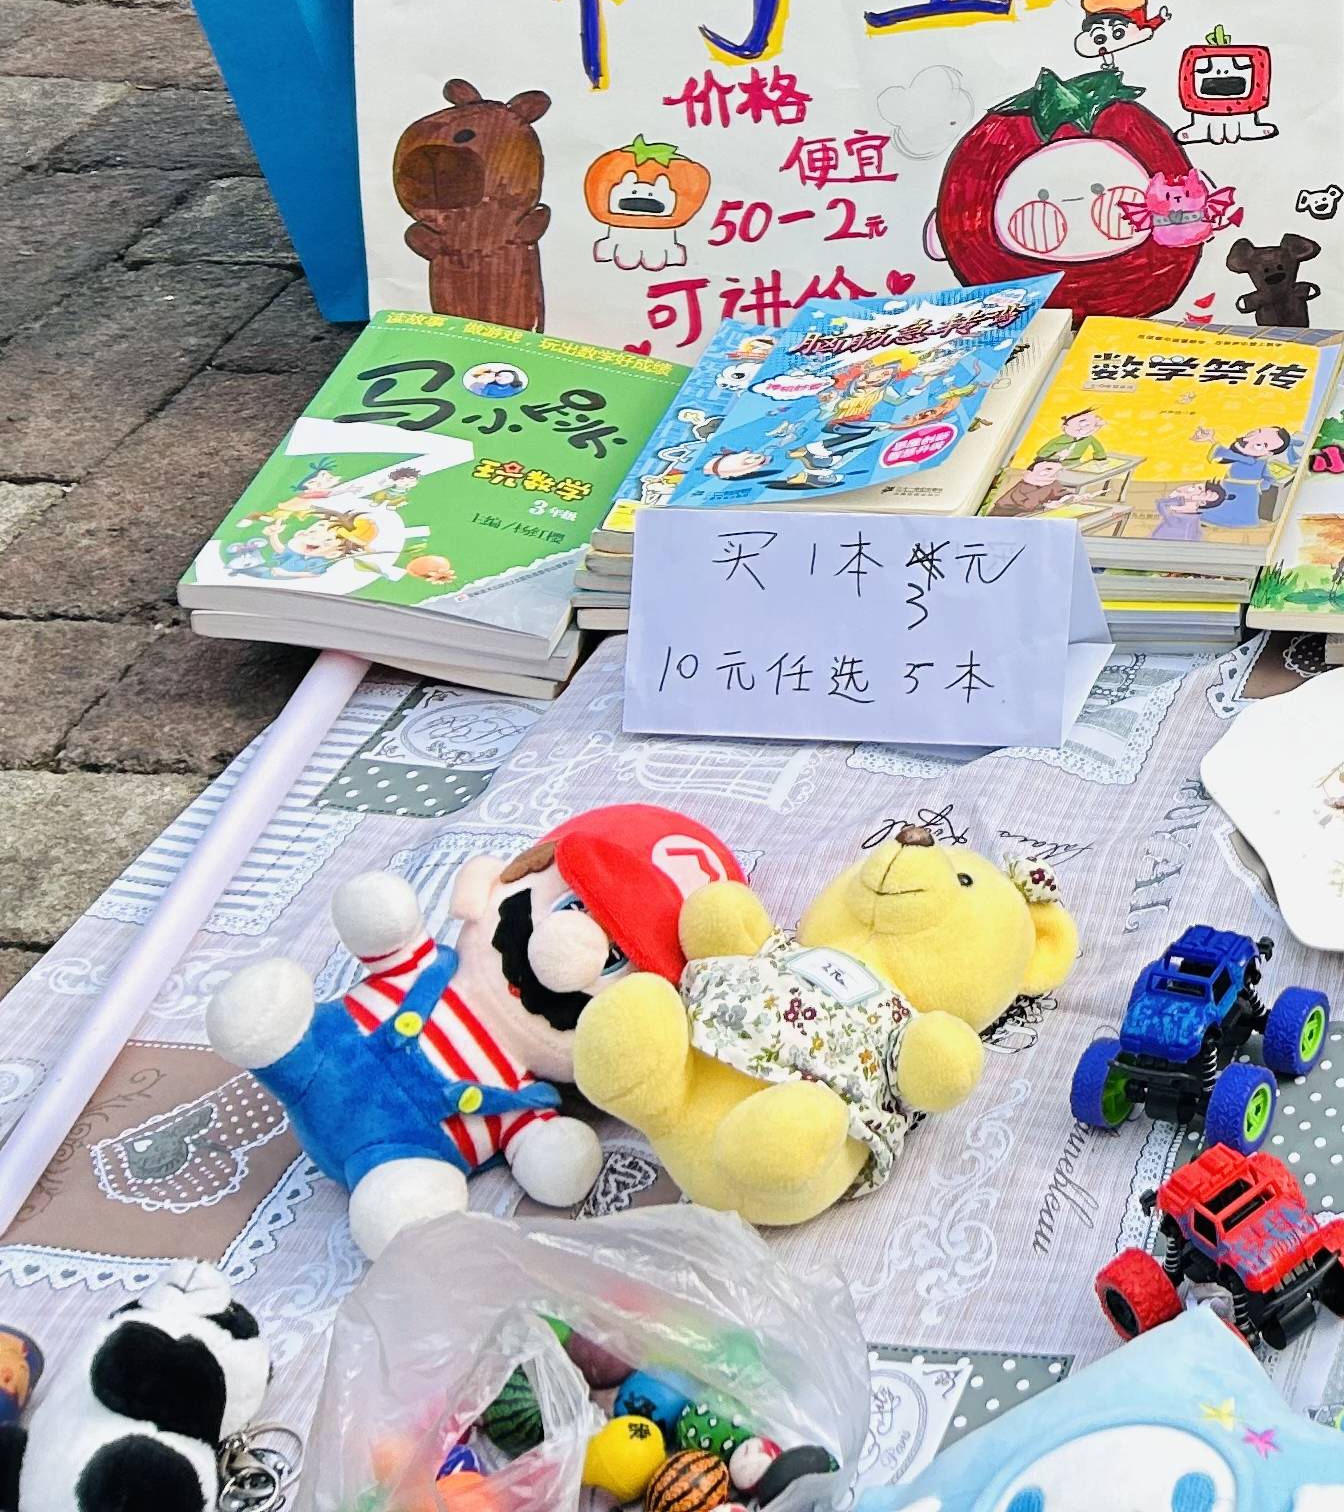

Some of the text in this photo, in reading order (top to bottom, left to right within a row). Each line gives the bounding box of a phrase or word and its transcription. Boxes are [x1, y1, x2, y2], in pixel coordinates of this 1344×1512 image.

[662, 65, 814, 129] 价格
[779, 128, 900, 192] 便宜
[1091, 352, 1310, 390] 数学笑传
[472, 458, 593, 502] 玩数学
